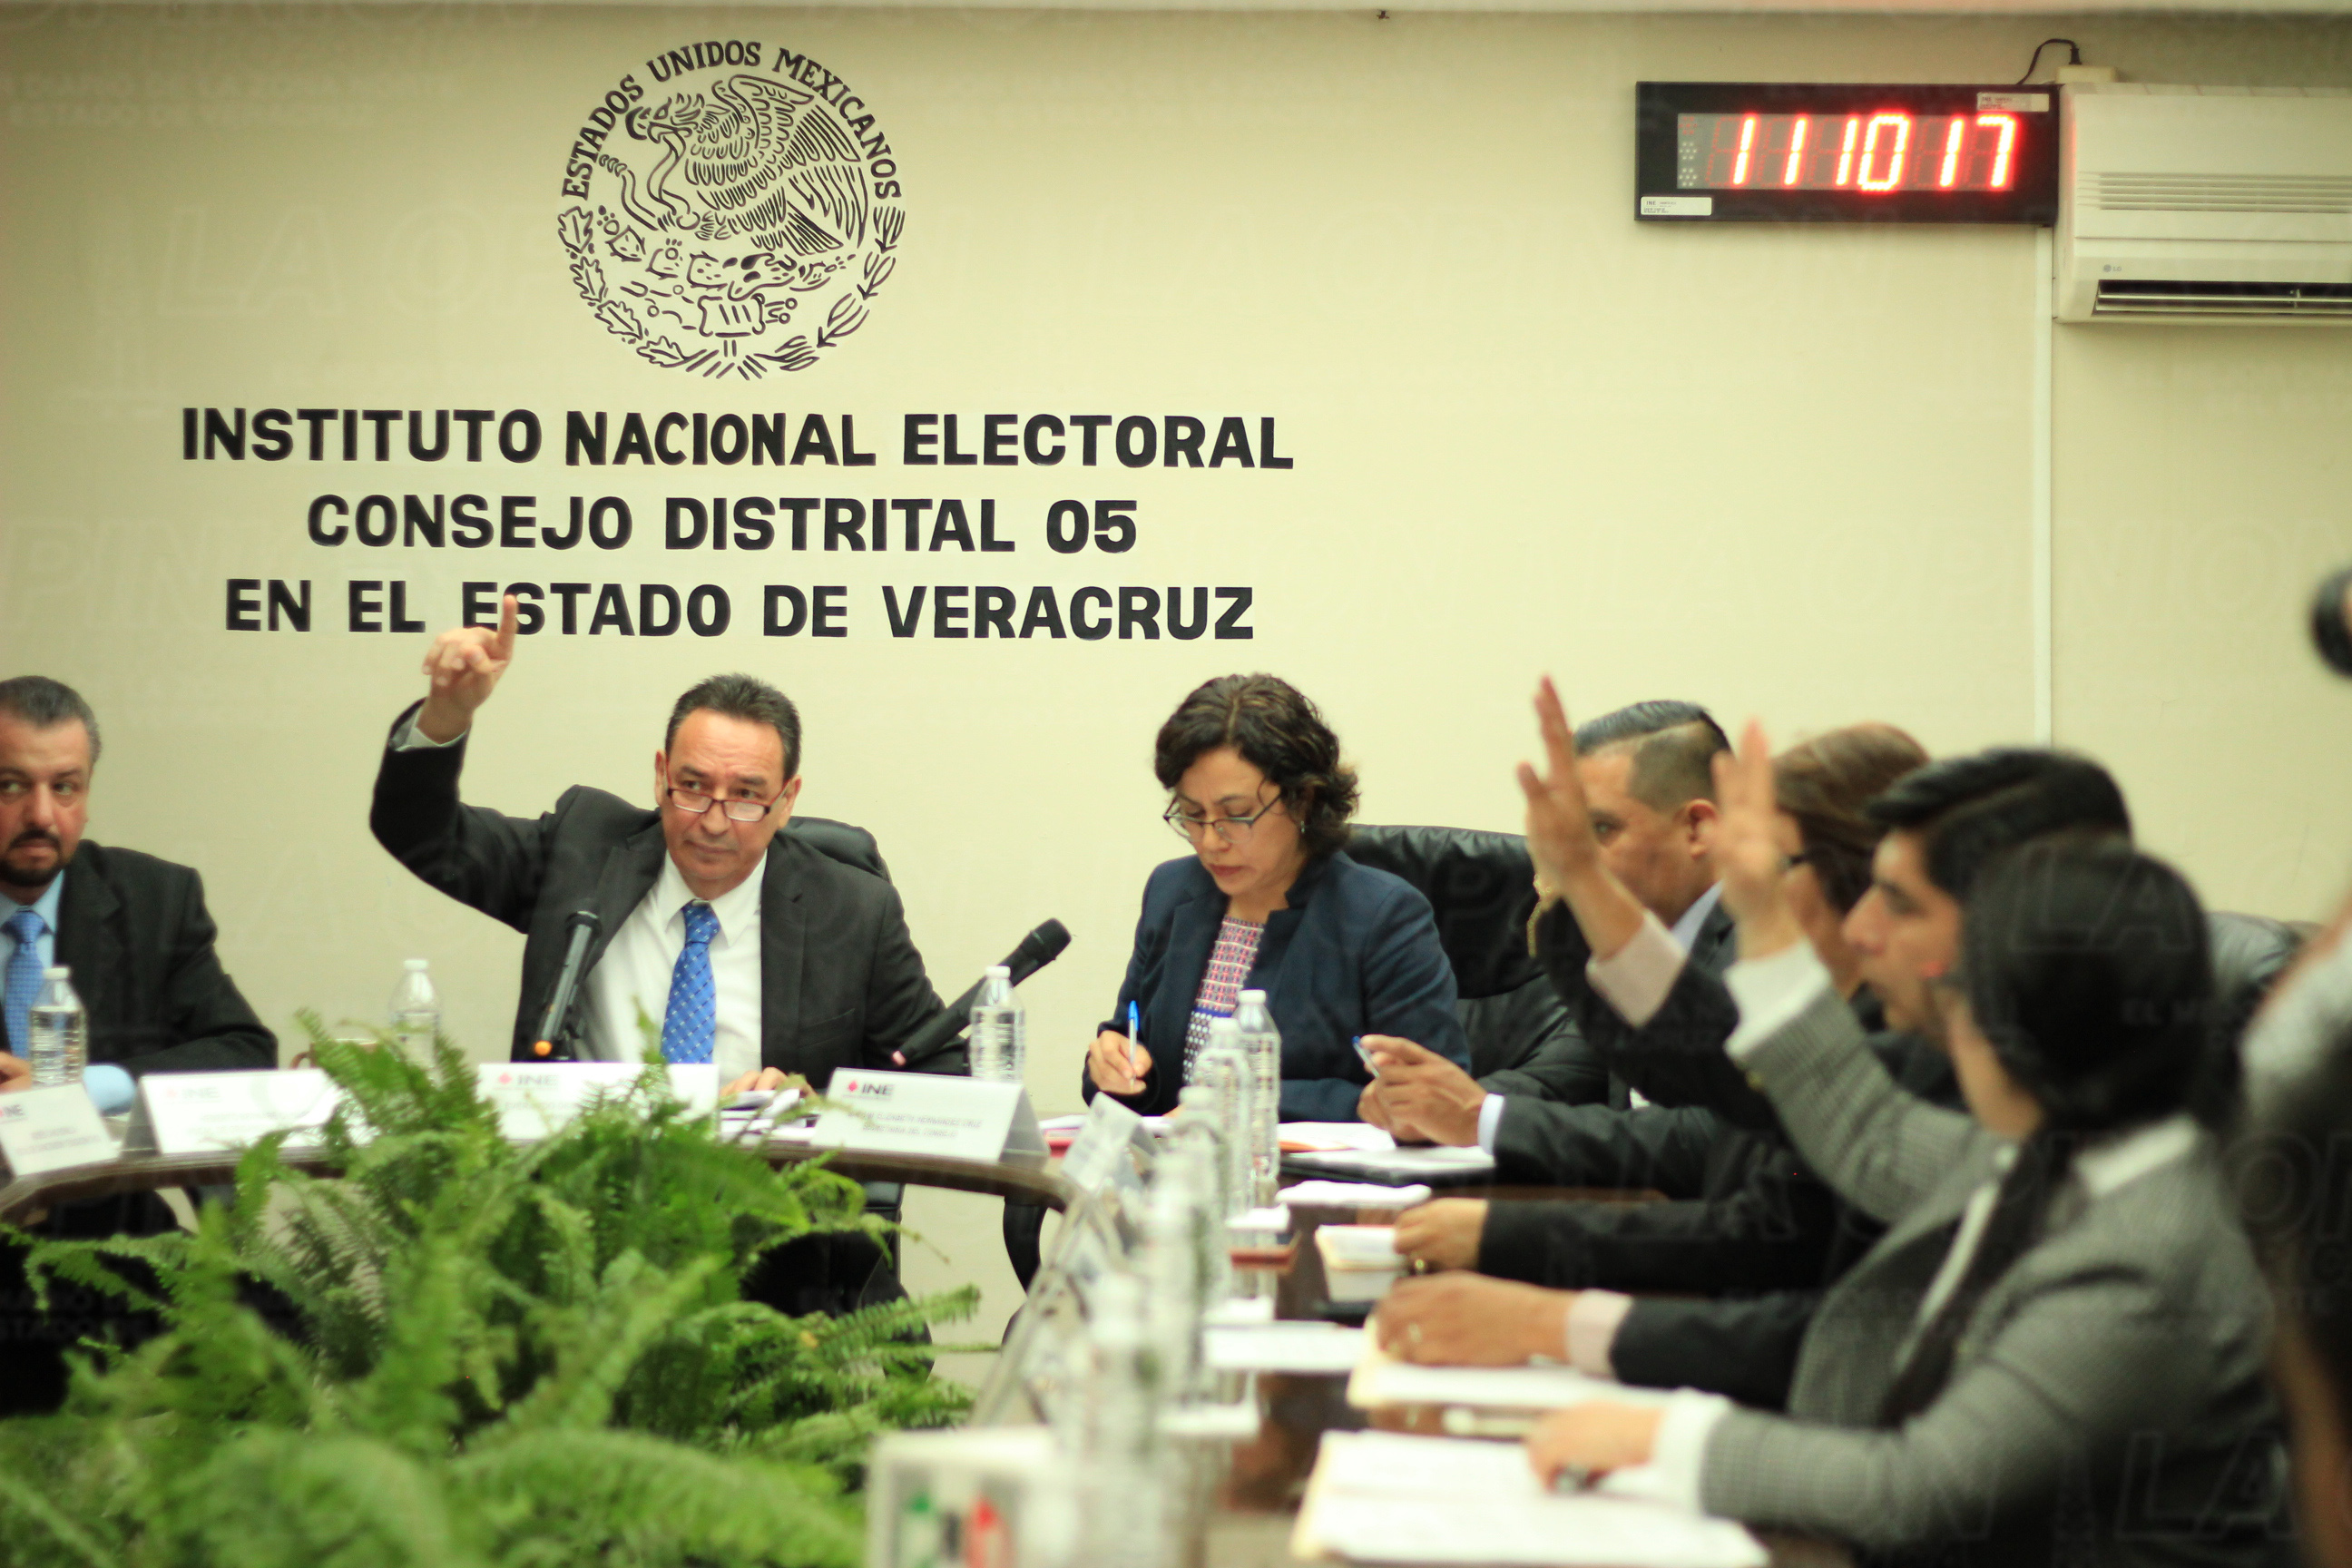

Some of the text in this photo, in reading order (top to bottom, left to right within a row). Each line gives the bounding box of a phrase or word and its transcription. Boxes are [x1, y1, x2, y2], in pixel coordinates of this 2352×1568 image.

[562, 74, 645, 201] ESTADOS
[646, 39, 761, 83] UNIDOS
[772, 47, 902, 200] MEXICANOS
[182, 407, 1294, 470] INSTITUTO NACIONAL ELECTORAL
[307, 494, 1138, 554] CONSEJO DISTRITAL 05
[225, 578, 1254, 640] EN EL ESTADO DE VERACRUZ
[861, 1083, 894, 1095] INE
